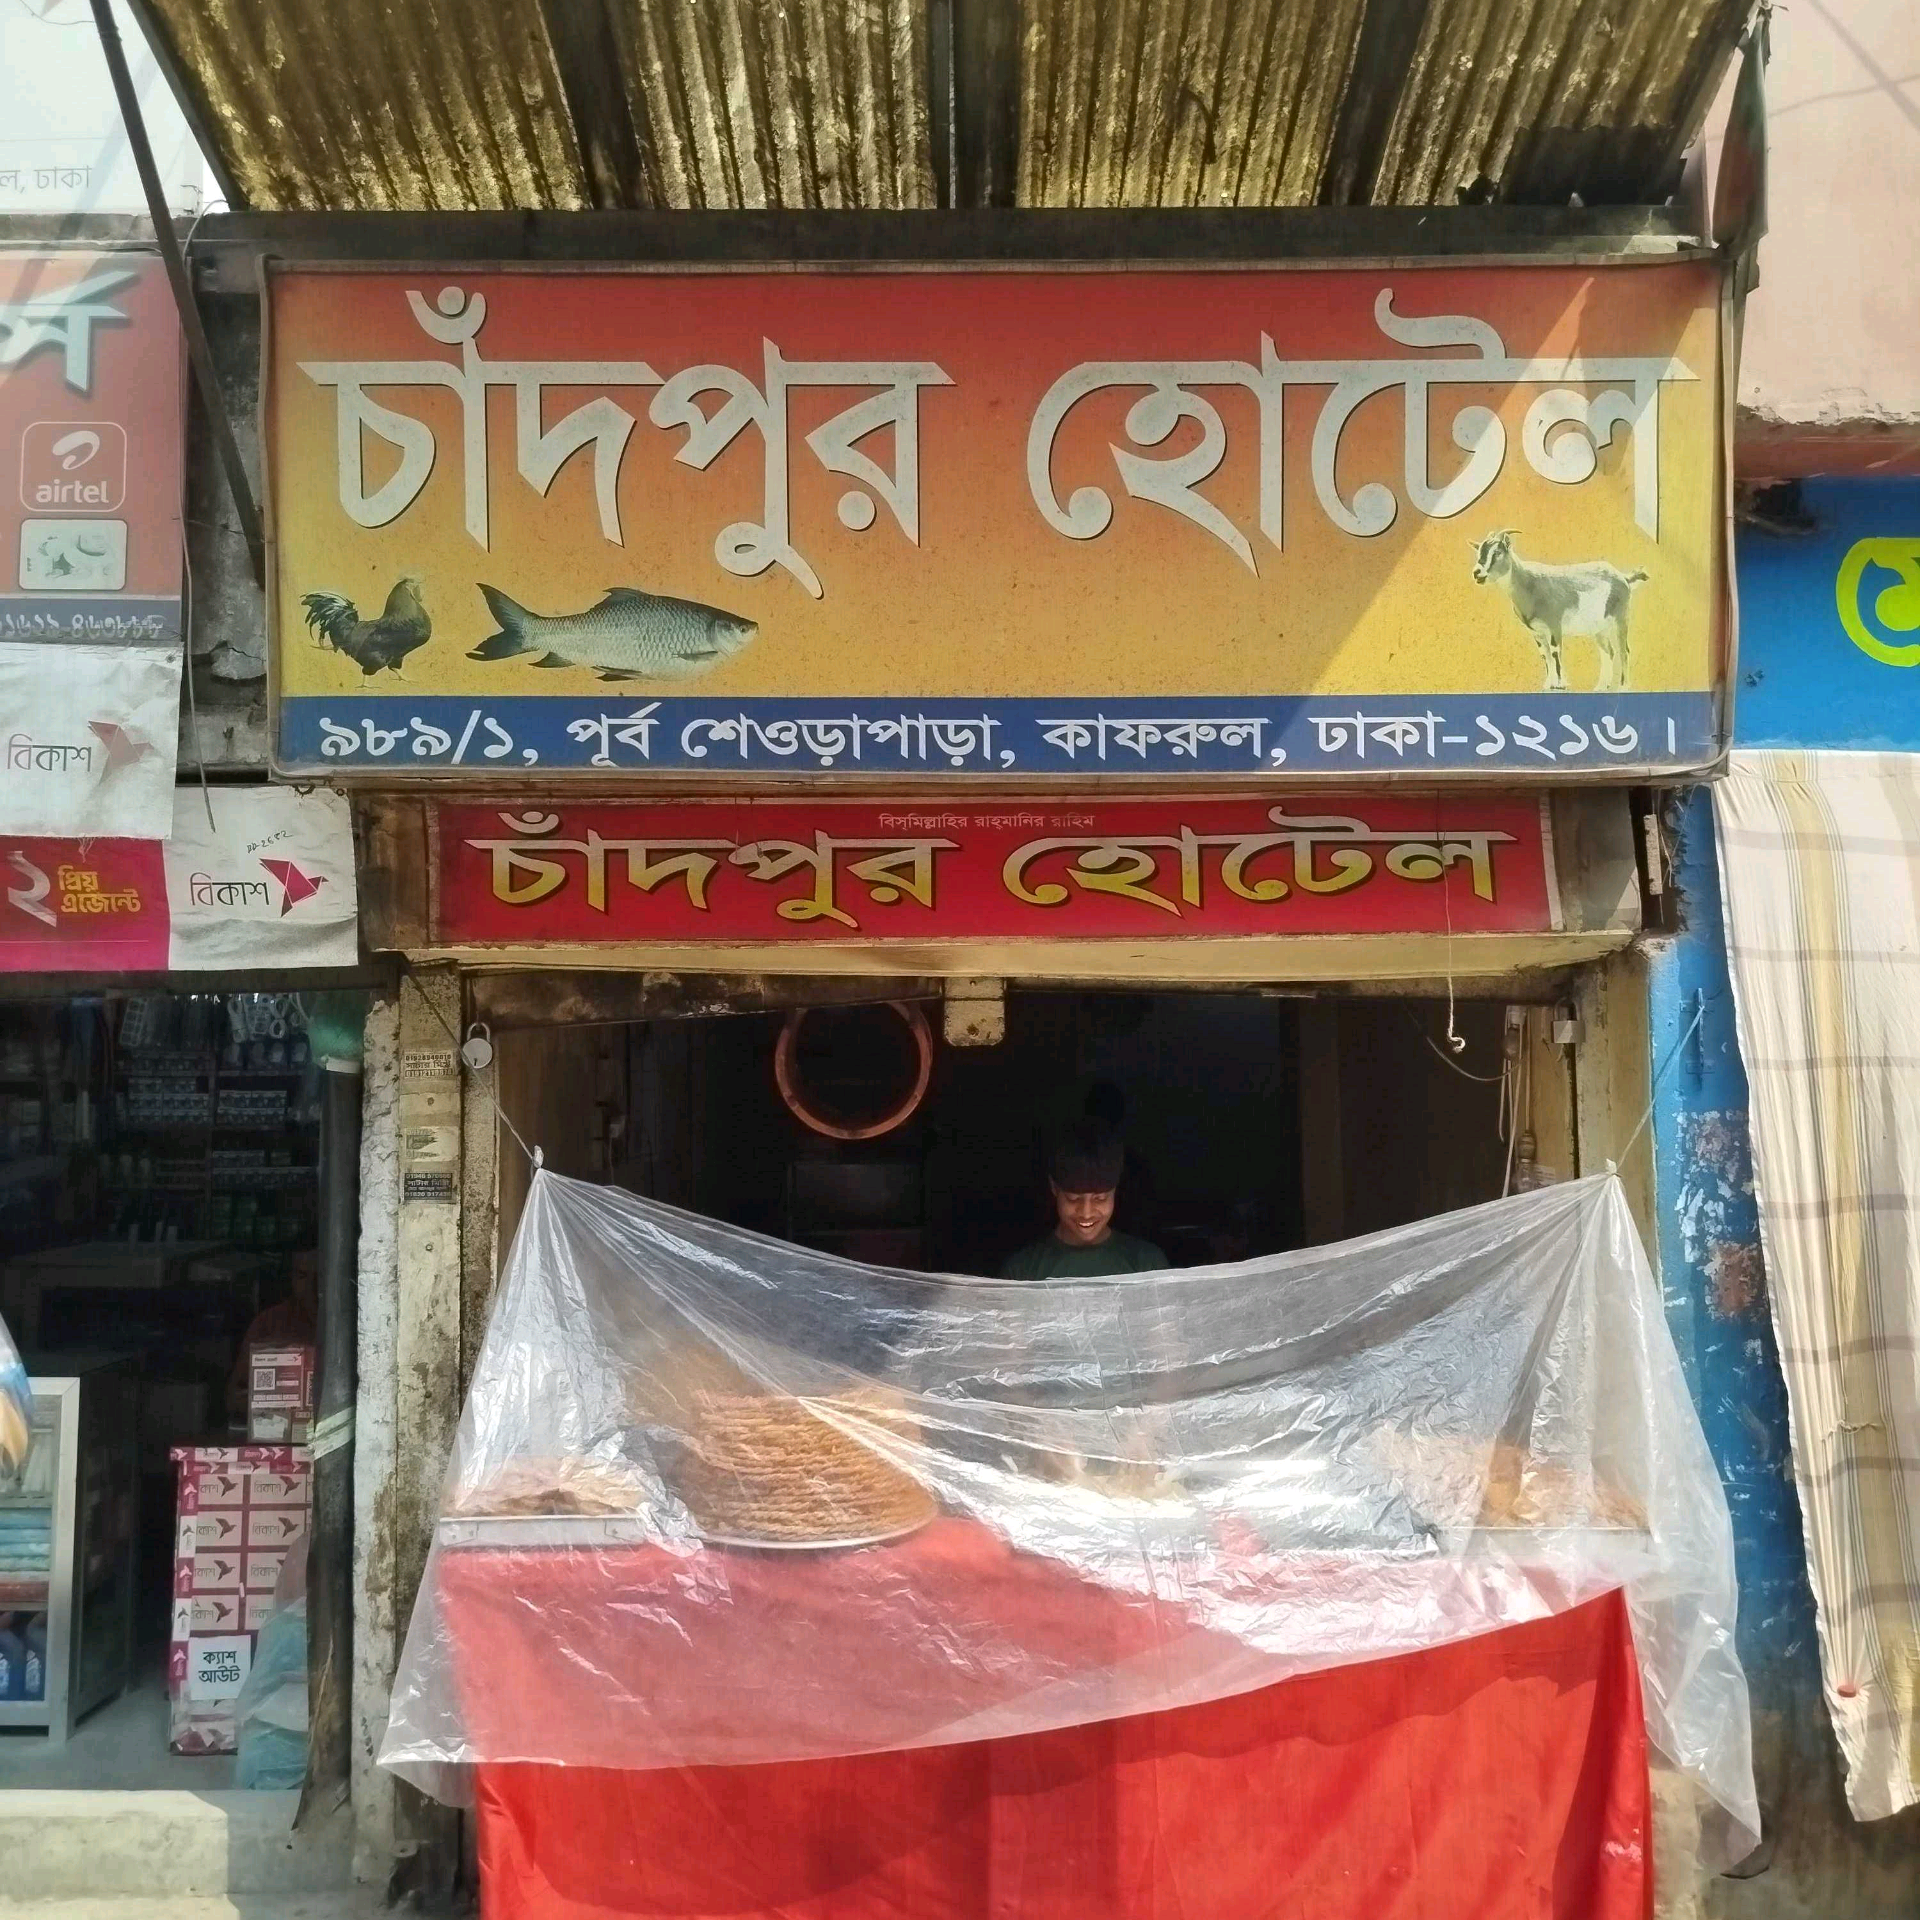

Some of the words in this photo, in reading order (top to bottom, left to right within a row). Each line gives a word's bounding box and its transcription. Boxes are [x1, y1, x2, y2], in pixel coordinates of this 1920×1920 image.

[33, 165, 92, 190] ঢাকা
[296, 286, 957, 600] চাঁদপুর
[1027, 287, 1700, 579] হোটেল
[35, 478, 109, 504] airtel
[319, 709, 539, 766] ৯৮৯/১,
[565, 701, 662, 768] পূর্ব
[680, 711, 1016, 769] শেওড়াপাড়া,
[1035, 712, 1288, 768] কাফরুল,
[7, 733, 92, 772] বিকাশ
[57, 864, 99, 892] প্রিয়
[463, 810, 961, 929] চাঁদপুর
[1002, 805, 1519, 918] হোটেল
[190, 872, 269, 906] বিকাশ
[203, 1650, 237, 1665] ক্যাশ
[198, 1668, 241, 1684] আউট
